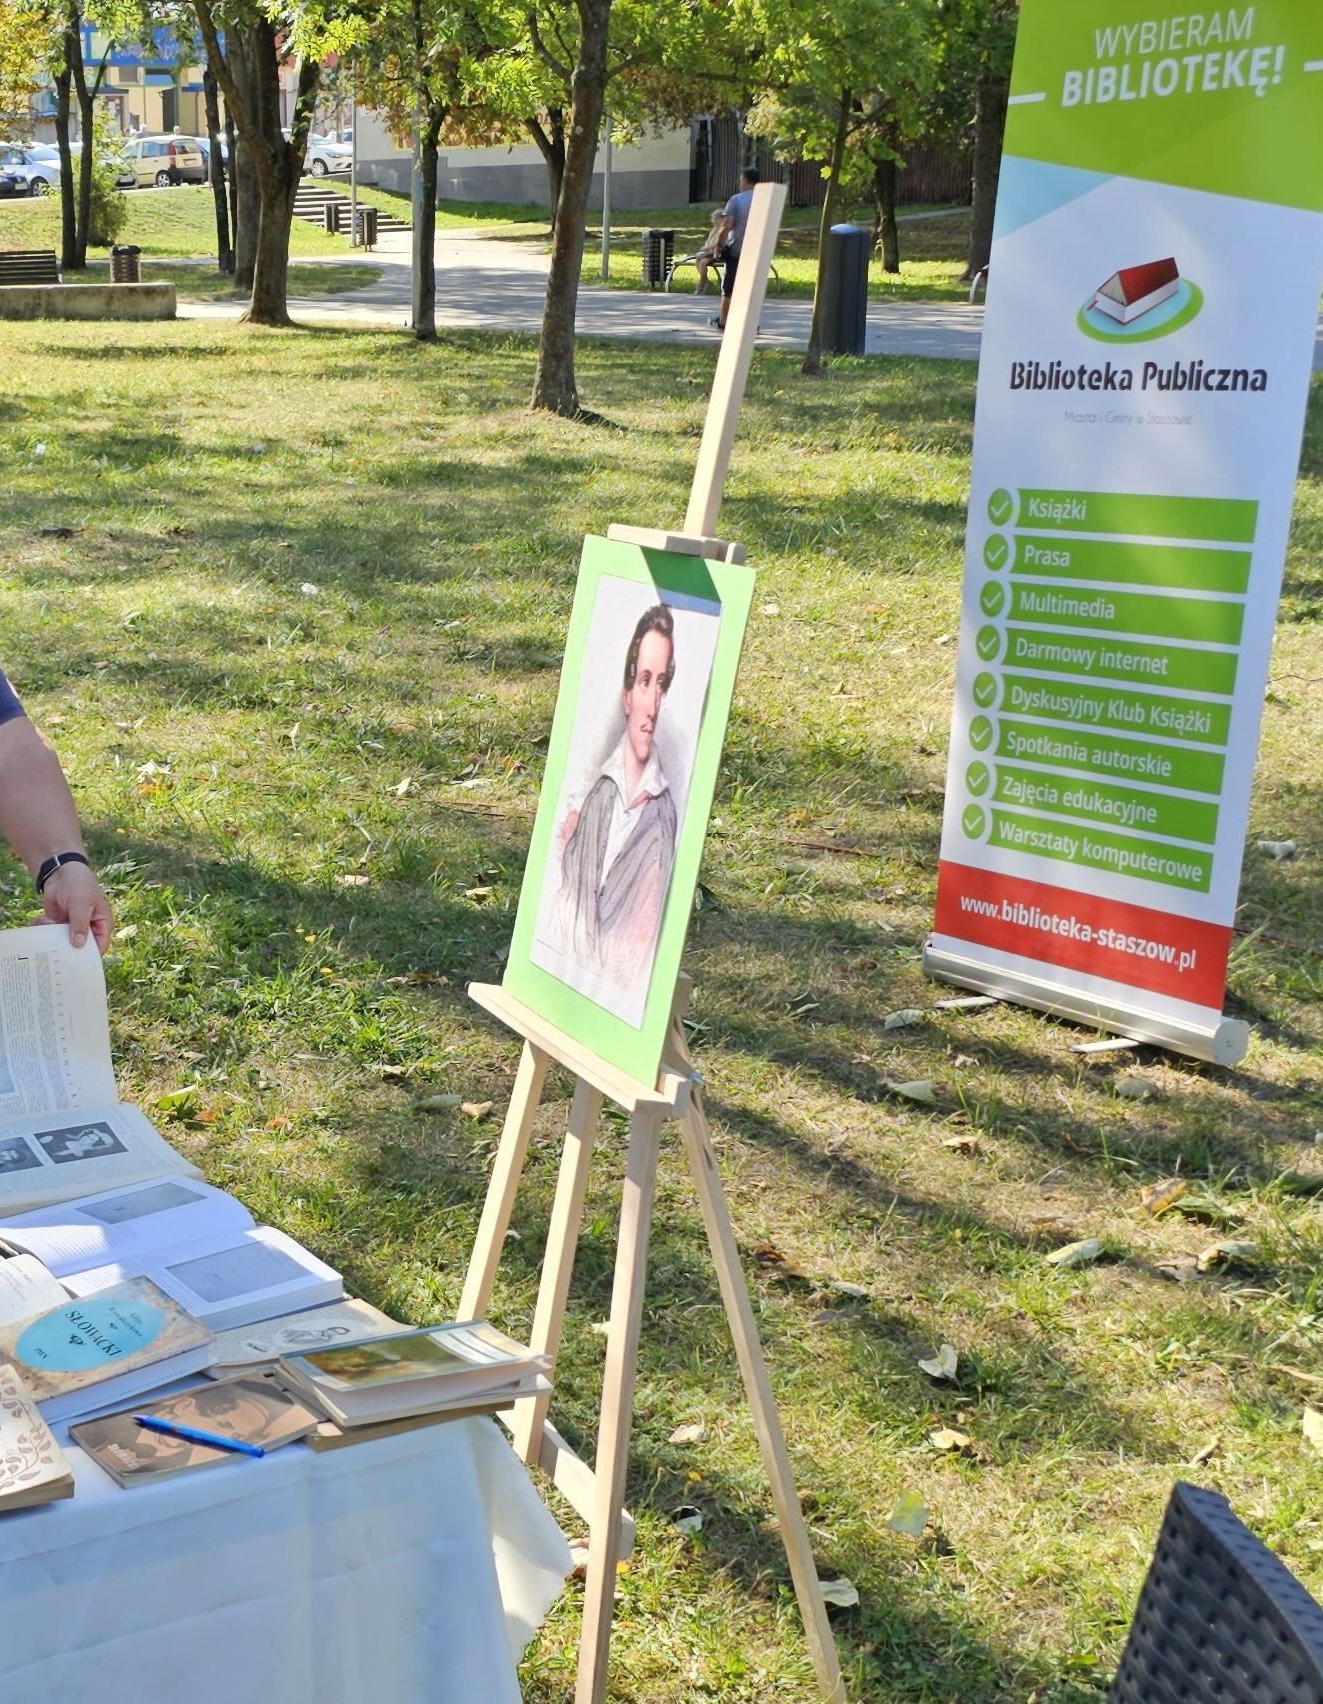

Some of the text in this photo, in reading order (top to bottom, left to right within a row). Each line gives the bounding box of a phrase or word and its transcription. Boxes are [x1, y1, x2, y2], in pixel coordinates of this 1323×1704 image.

[1094, 7, 1255, 59] WYBIERAM
[1061, 45, 1285, 108] BIBLIOTEKĘ!
[1009, 359, 1268, 392] Biblioteka Publiczna
[1028, 497, 1087, 524] Książki
[1023, 545, 1071, 567] Prasa
[1019, 591, 1115, 620] Multimedia
[1015, 637, 1169, 676] Darmowy internet
[1011, 685, 1212, 736] Dyskusyjny Klub Książki
[1006, 731, 1172, 777] Spotkania autorskie
[1001, 775, 1158, 825] Zajęcia edukacyjne
[998, 820, 1203, 883] Warsztaty komputerowe
[960, 895, 1197, 973] www.biblioteka-staszow.pl
[65, 1310, 122, 1357] SŁOWACKI
